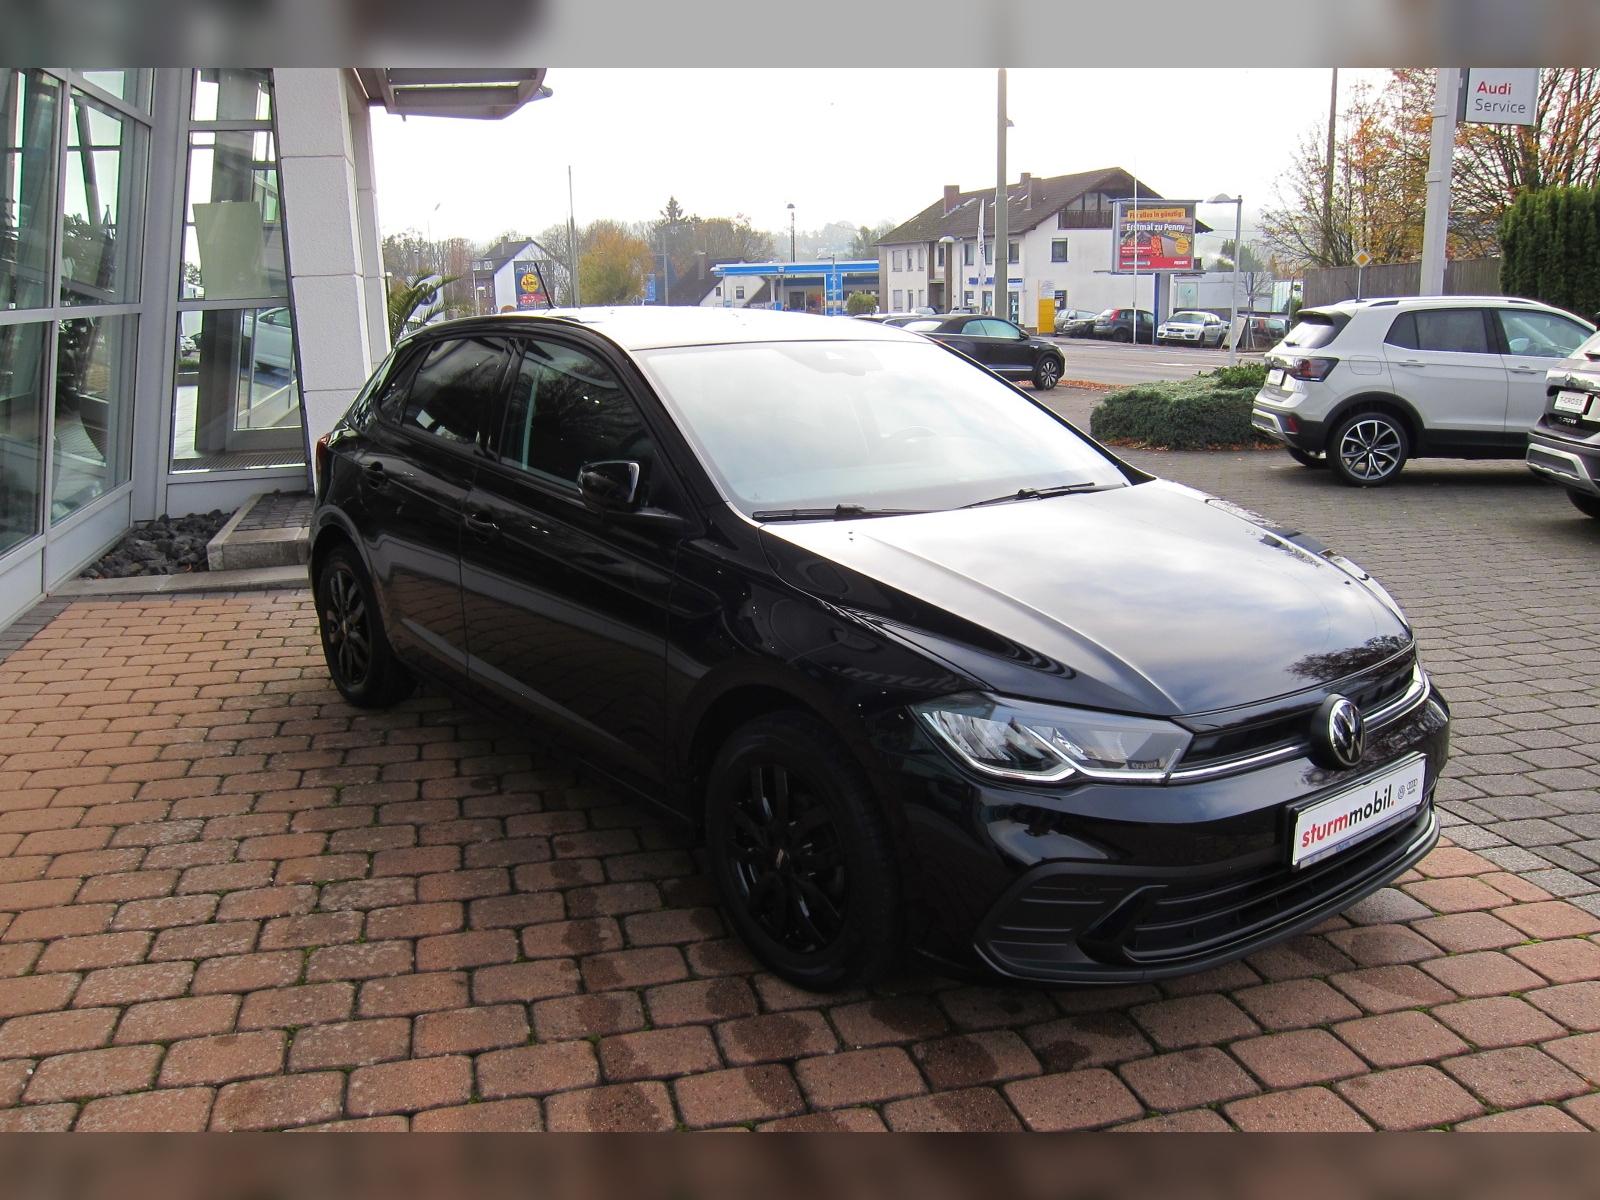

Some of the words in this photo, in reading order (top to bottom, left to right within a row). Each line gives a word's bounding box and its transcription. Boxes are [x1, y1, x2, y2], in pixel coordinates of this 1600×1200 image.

[1477, 81, 1511, 95] Audi
[1475, 98, 1526, 114] Service
[1164, 223, 1185, 232] Penny
[1302, 784, 1395, 848] sturmmobil.
